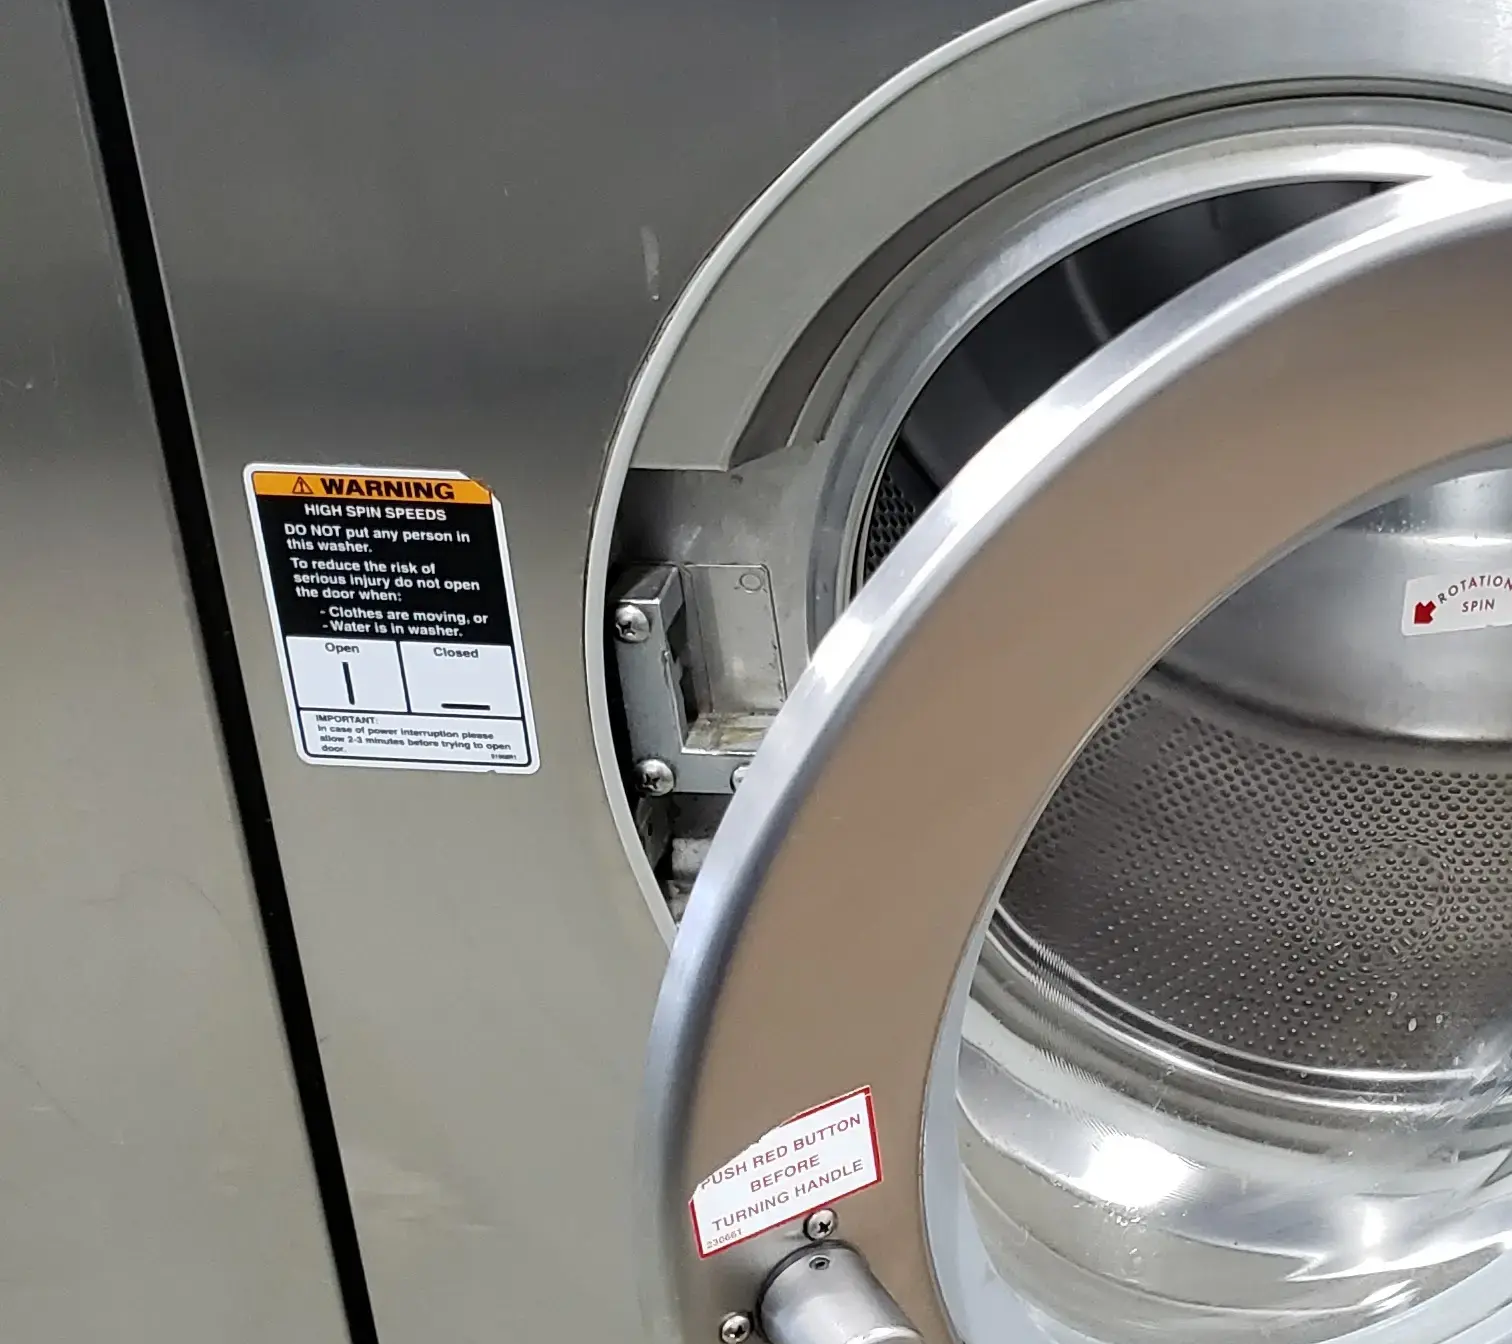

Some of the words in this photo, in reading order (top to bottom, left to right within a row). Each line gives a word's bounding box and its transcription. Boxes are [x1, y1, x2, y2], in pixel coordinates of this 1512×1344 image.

[320, 477, 455, 499] WARNING
[304, 503, 342, 517] HIGH
[346, 506, 382, 519] SPIN
[385, 507, 447, 521] SPEEDS
[284, 523, 307, 536] DO
[310, 525, 341, 538] NOT
[345, 527, 370, 540] put
[373, 528, 398, 542] any
[402, 530, 452, 543] person
[456, 530, 470, 543] in
[286, 538, 314, 551] this
[317, 540, 373, 553] washer.
[289, 557, 308, 569] To
[311, 560, 360, 572] reduce
[364, 562, 387, 573] the
[390, 563, 418, 574] risk
[421, 563, 436, 575] of
[293, 574, 346, 585] serious
[350, 575, 390, 589] injury
[394, 577, 413, 588] do
[416, 578, 441, 589] not
[443, 580, 480, 592] open
[295, 586, 318, 598] the
[322, 588, 355, 599] door
[358, 590, 402, 602] when:
[1462, 599, 1495, 613] SPIN
[328, 606, 384, 619] Clothes
[386, 610, 410, 621] are
[413, 611, 470, 625] moving,
[473, 613, 489, 624] or
[330, 620, 370, 633] Water
[374, 622, 387, 634] is
[391, 623, 404, 635] in
[408, 624, 463, 637] washer.
[324, 642, 360, 654] Open
[433, 646, 479, 659] Closed
[315, 714, 379, 725] IMPORTANT:
[330, 725, 352, 733] case
[355, 725, 365, 735] of
[368, 728, 398, 737] power
[401, 728, 459, 739] interruption
[462, 732, 494, 741] please
[320, 734, 345, 743] allow
[347, 736, 363, 744] 2-3
[366, 737, 405, 747] minutes
[408, 738, 439, 748] before
[441, 741, 471, 752] trying
[473, 741, 483, 751] to
[486, 743, 512, 752] open
[321, 744, 347, 752] door.
[752, 1144, 788, 1169] RED
[792, 1113, 862, 1152] BUTTON
[750, 1154, 821, 1193] BEFORE
[712, 1191, 789, 1231] TURNING
[794, 1159, 864, 1197] HANDLE
